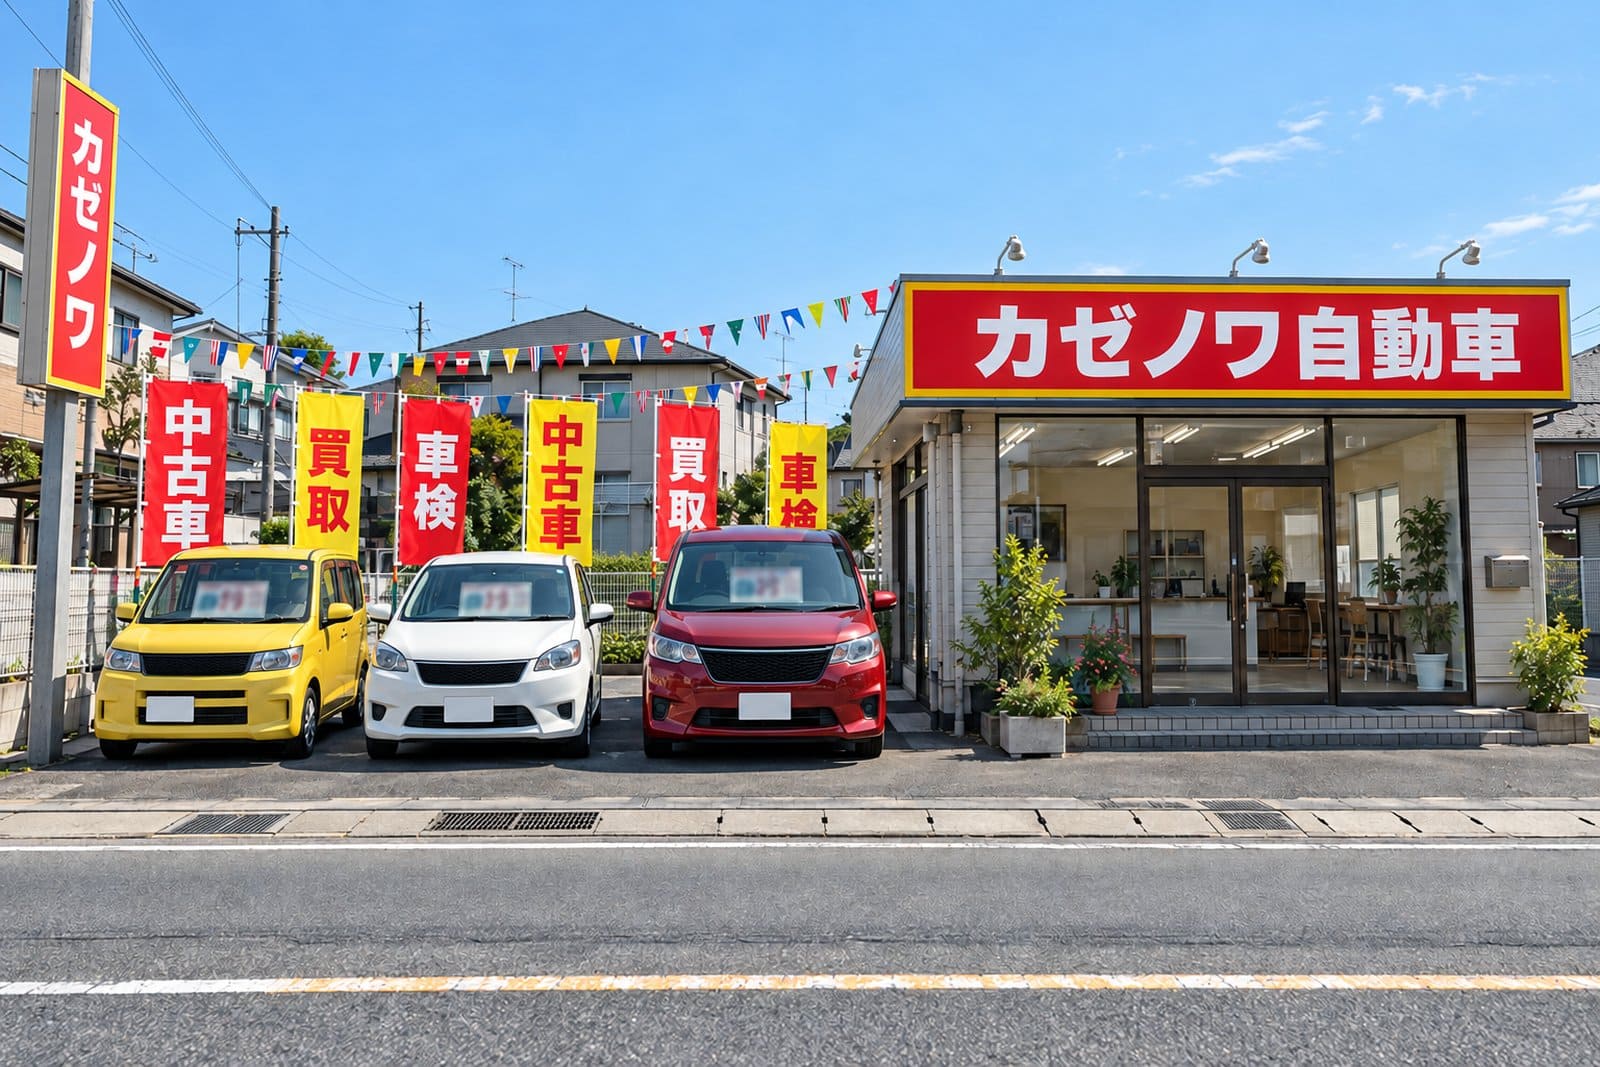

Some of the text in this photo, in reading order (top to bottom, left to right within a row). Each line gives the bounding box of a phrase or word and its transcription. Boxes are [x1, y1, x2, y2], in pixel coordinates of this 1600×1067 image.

[65, 118, 104, 350] カゼノワ
[974, 302, 1522, 382] カゼノワ自動車
[161, 398, 212, 549] 中古車
[306, 428, 351, 534] 買取
[413, 430, 459, 531] 車検
[539, 414, 583, 550] 中古車
[668, 436, 707, 531] 買取
[780, 452, 818, 529] 車検
